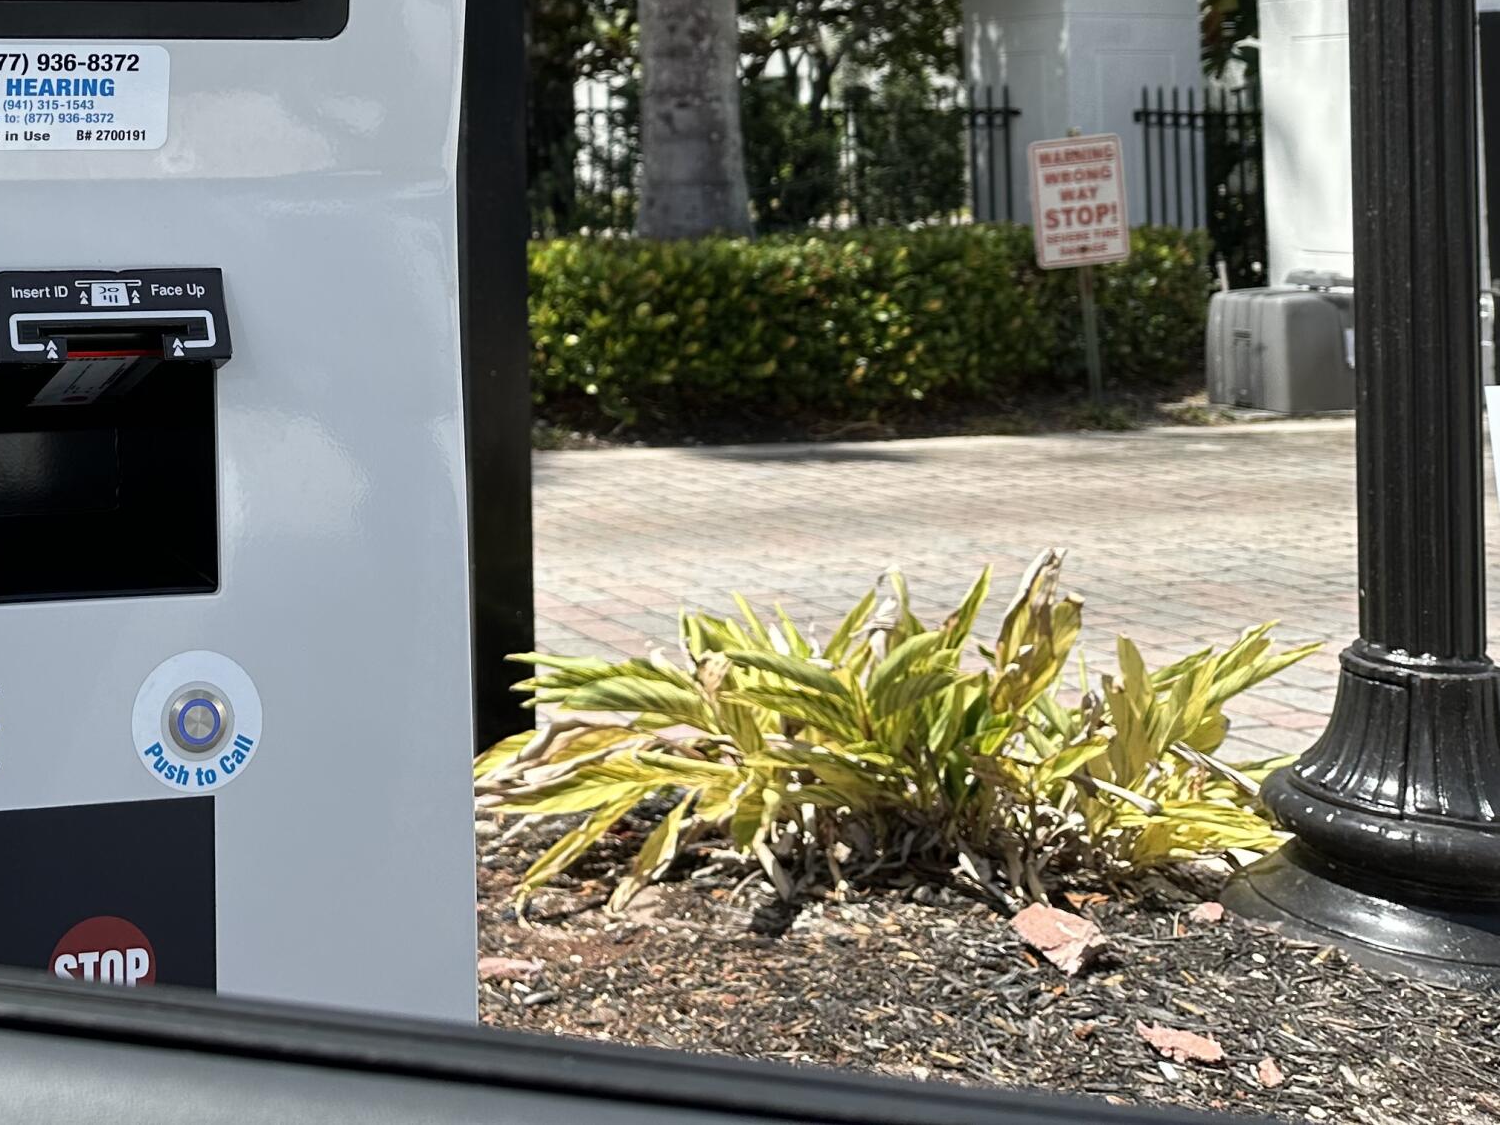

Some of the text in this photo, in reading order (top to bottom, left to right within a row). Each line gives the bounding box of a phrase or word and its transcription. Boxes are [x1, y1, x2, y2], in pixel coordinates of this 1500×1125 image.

[37, 53, 139, 72] 936-8372
[6, 78, 115, 97] HEARING
[3, 99, 33, 112] (941)
[37, 100, 94, 110] 315-1543
[4, 113, 20, 123] to:
[24, 113, 54, 125] (877)
[58, 113, 114, 123] 936-8372
[5, 131, 18, 142] in
[5, 131, 18, 142] in
[24, 131, 51, 142] Use
[76, 130, 145, 141] B# 2700191
[1039, 145, 1114, 164] WARNING
[1043, 166, 1112, 184] WRONG
[1060, 187, 1098, 201] WAY
[1045, 202, 1117, 229] STOP!
[11, 286, 68, 298] Insert ID
[151, 283, 205, 298] Face Up
[144, 734, 254, 786] Push to Call
[54, 947, 150, 988] STOP
